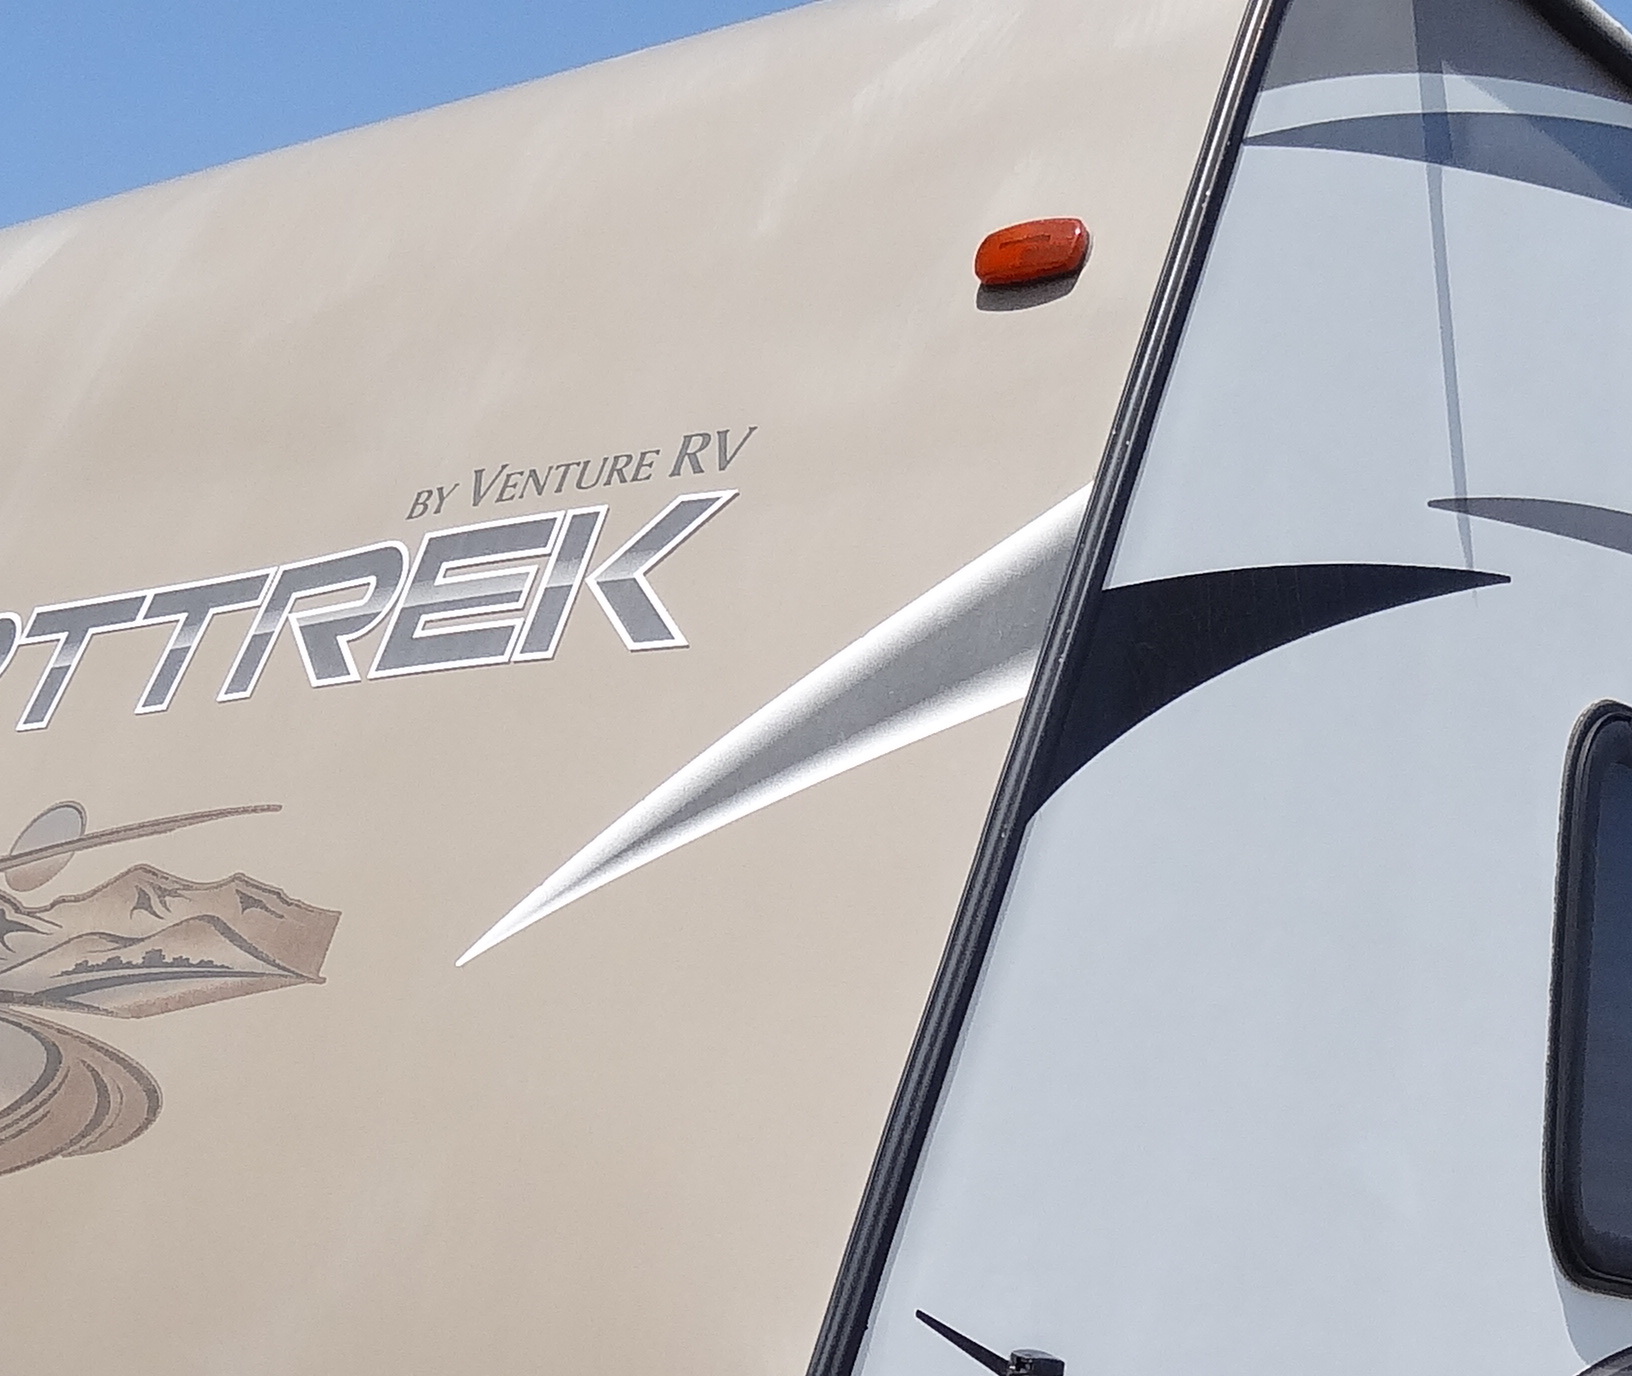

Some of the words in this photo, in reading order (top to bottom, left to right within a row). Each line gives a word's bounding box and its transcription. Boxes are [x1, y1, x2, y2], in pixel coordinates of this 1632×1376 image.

[405, 482, 460, 521] BY
[471, 448, 661, 508] VENTURE
[668, 425, 759, 479] RV
